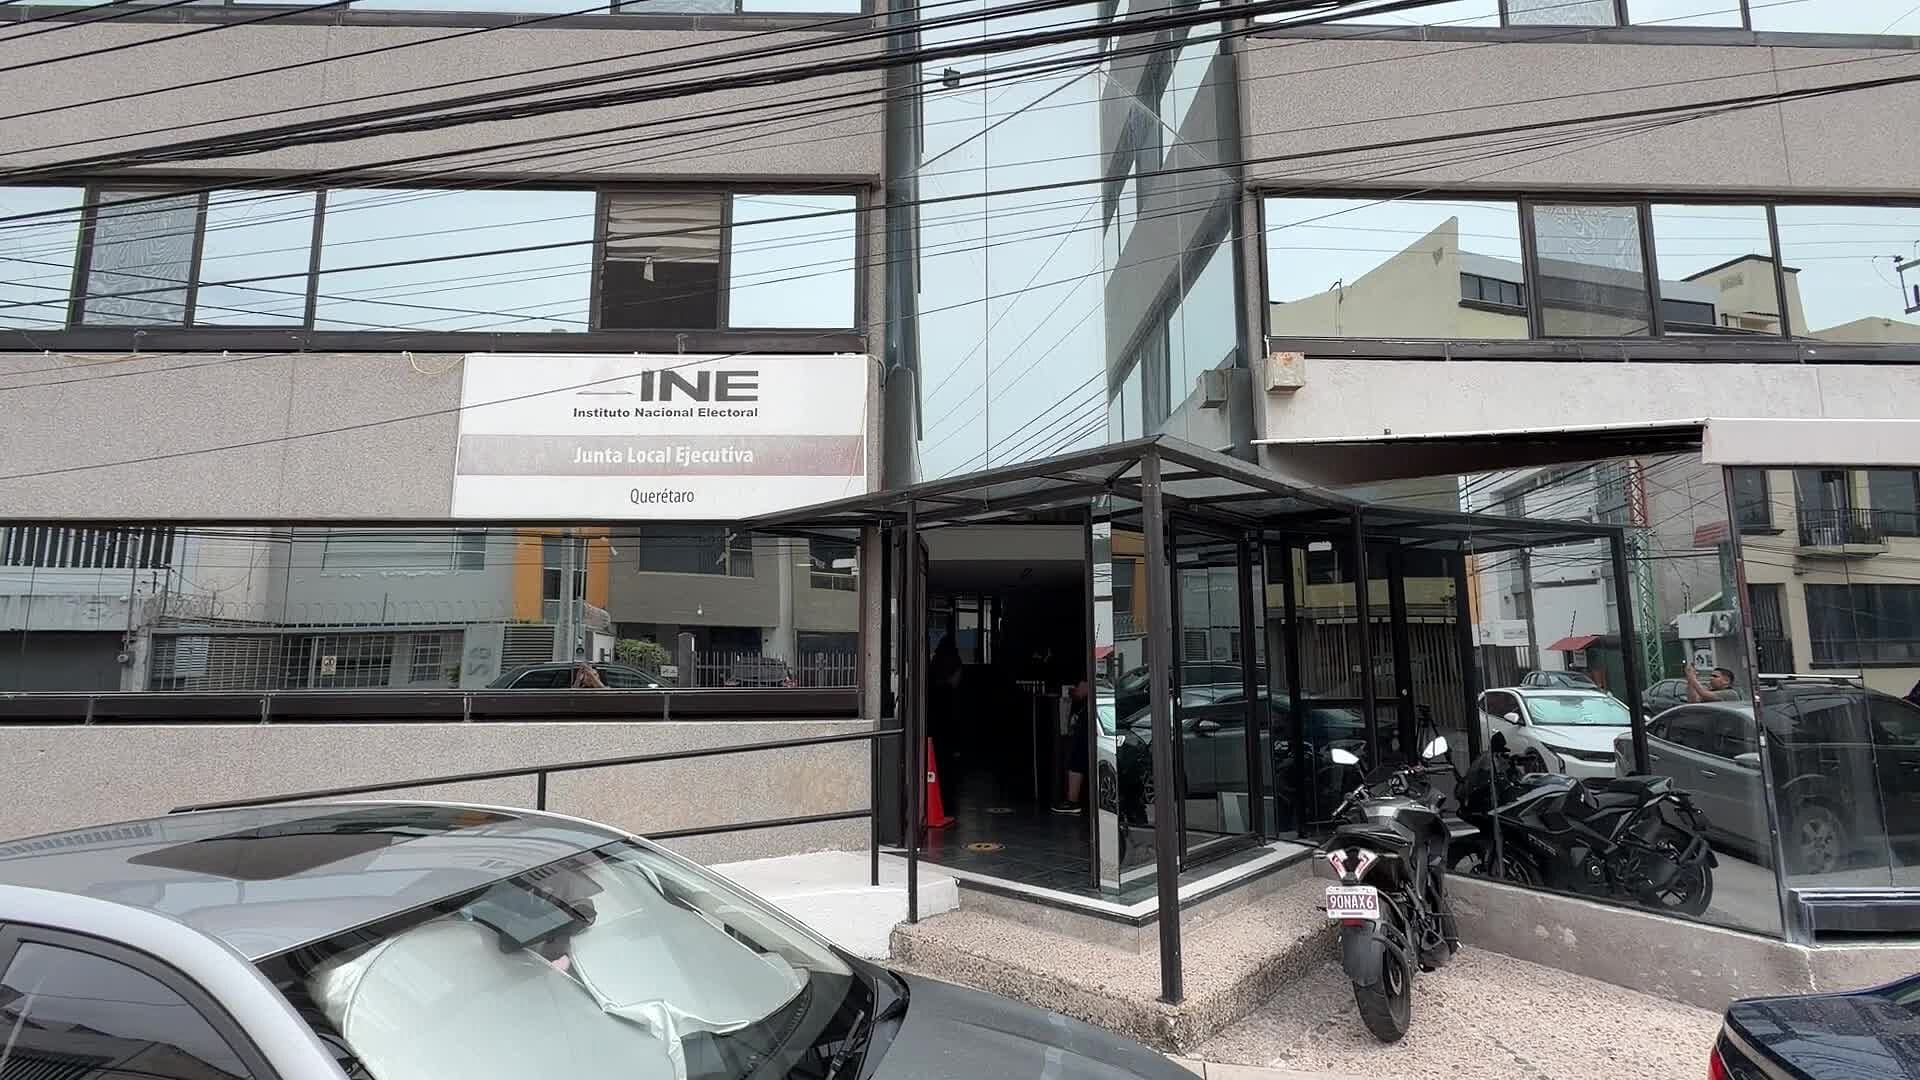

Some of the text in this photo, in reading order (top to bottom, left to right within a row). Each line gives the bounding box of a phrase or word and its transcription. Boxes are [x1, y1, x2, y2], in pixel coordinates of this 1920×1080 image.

[641, 370, 759, 401] INE
[573, 408, 758, 417] Instituto Nacional Electoral
[573, 446, 754, 466] Junta Local Ejecutiva
[630, 488, 695, 504] Querétaro
[1330, 896, 1374, 908] 90NAX6
